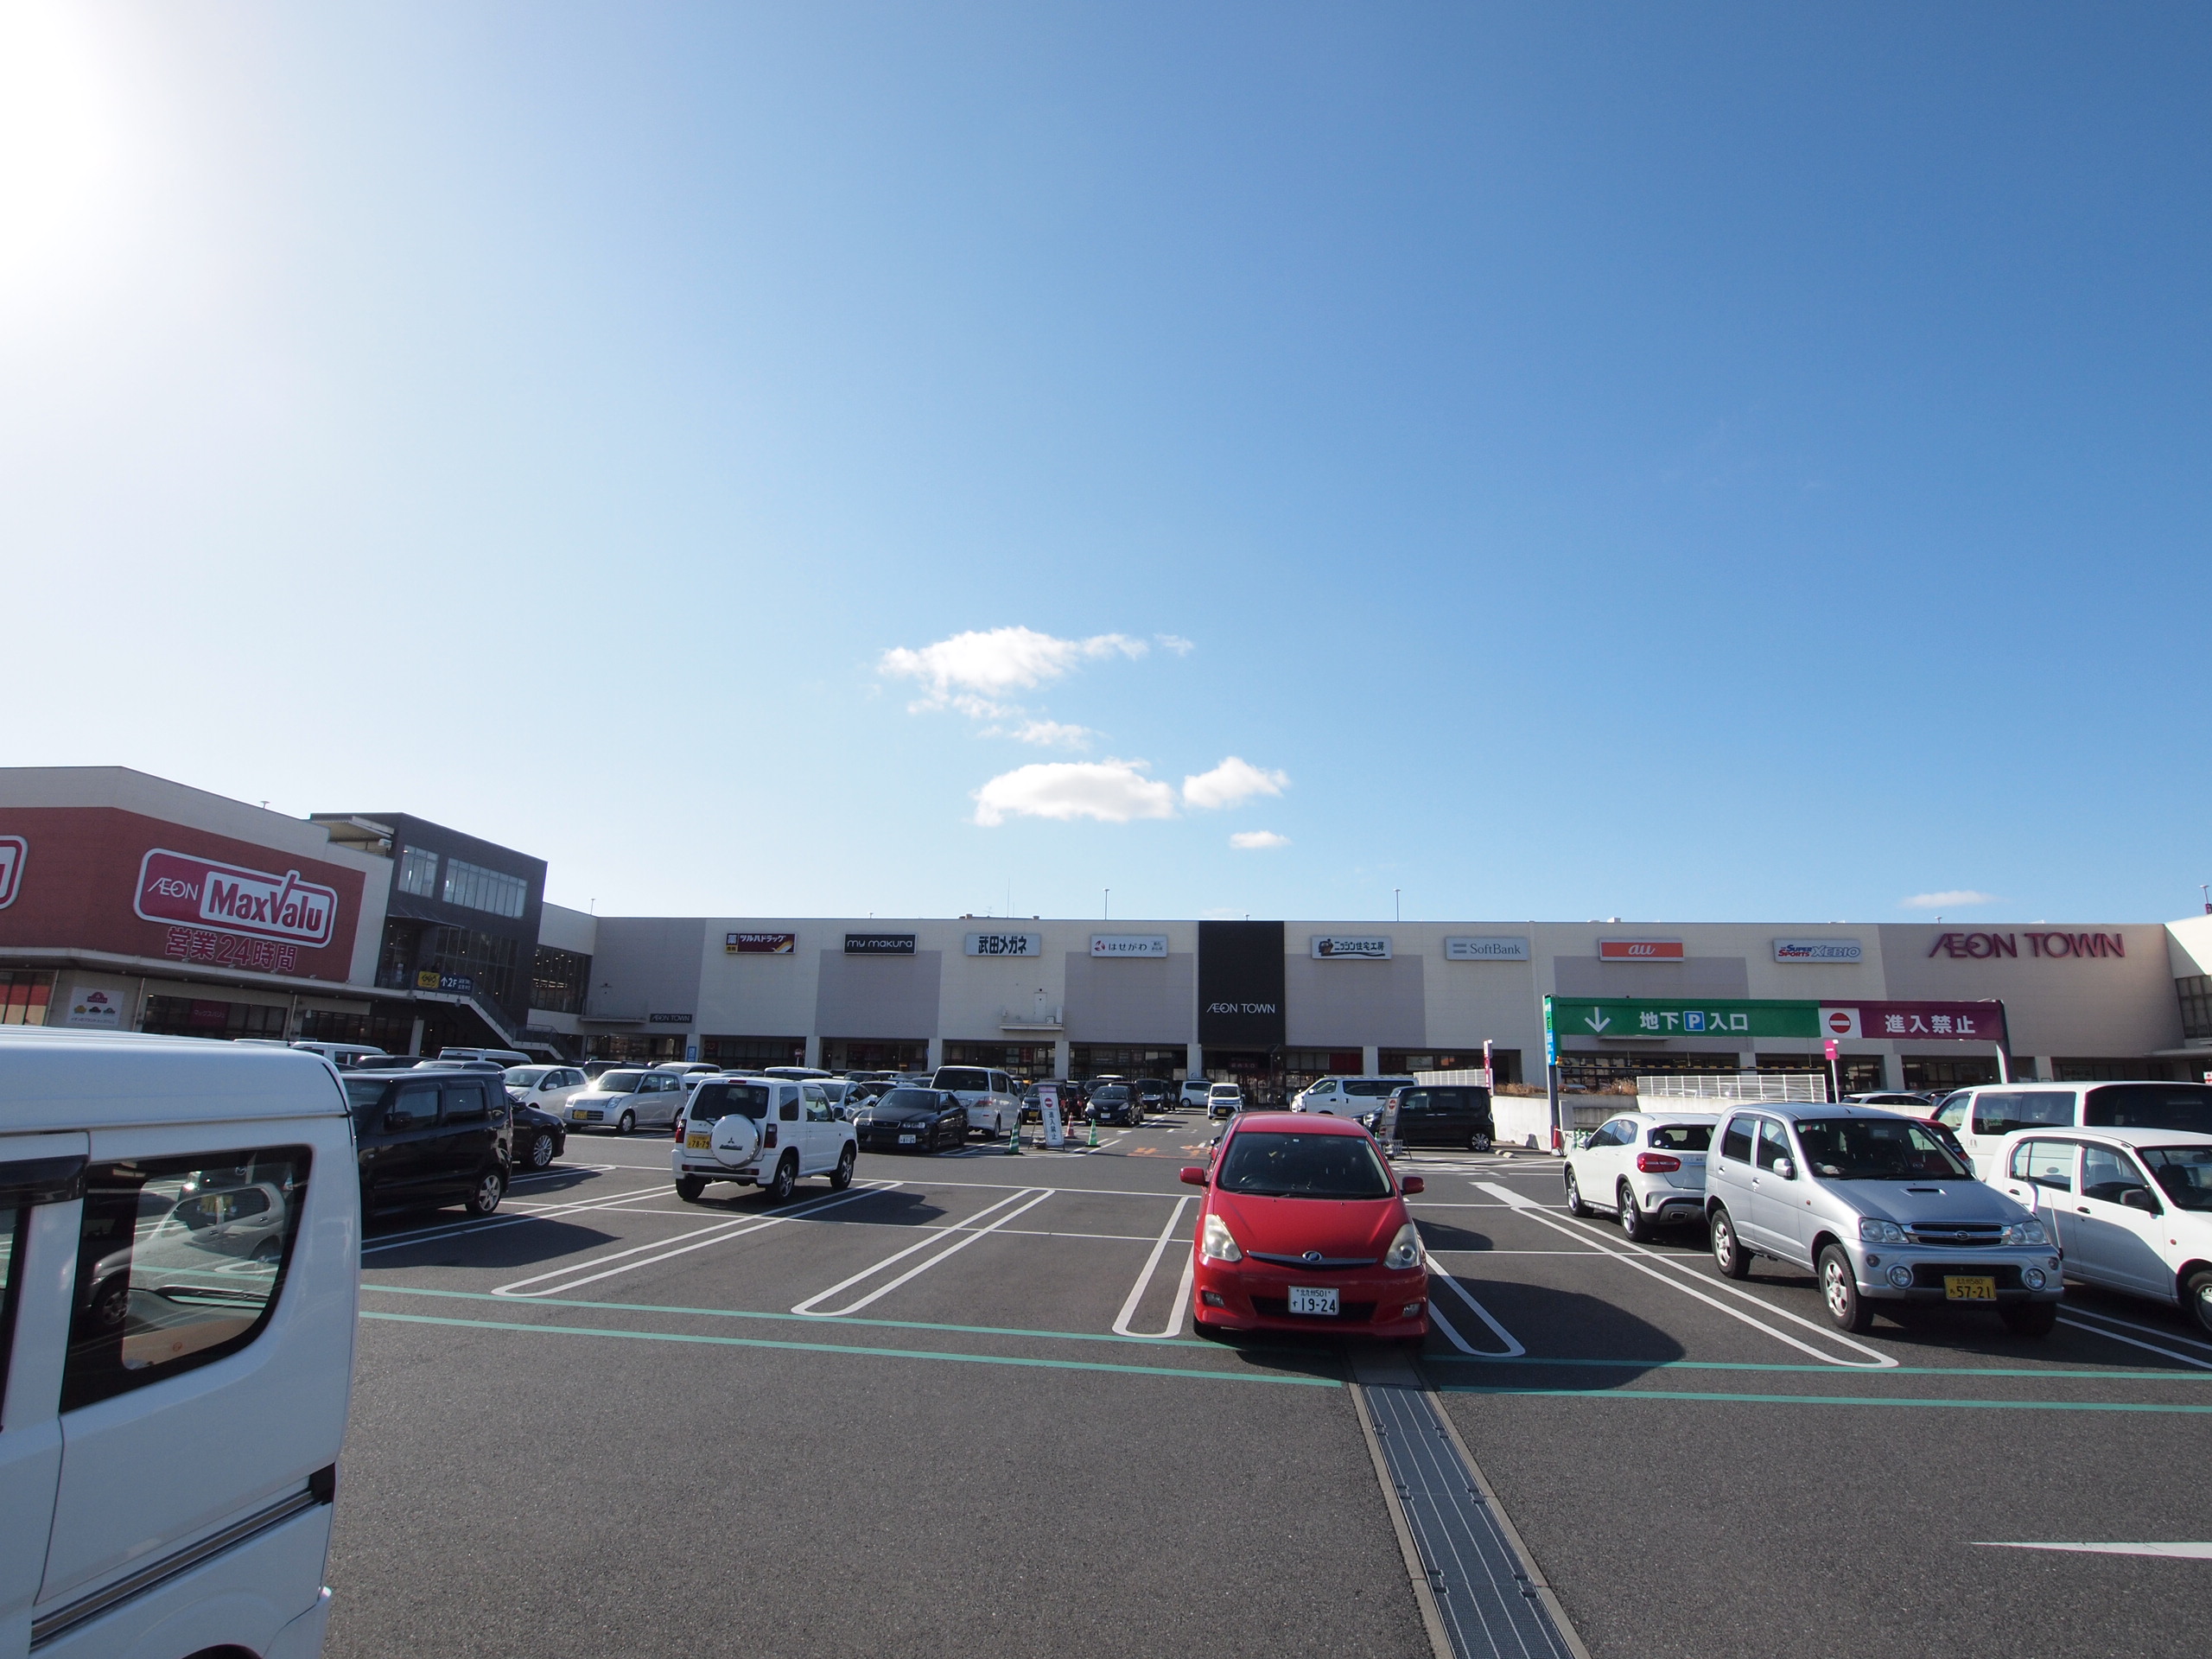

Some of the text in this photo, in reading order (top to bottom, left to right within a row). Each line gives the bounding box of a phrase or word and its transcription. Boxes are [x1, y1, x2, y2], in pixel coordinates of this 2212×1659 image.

[208, 874, 323, 931] MaxValu
[165, 927, 297, 972] 営業24時間
[847, 939, 912, 948] my makura
[978, 936, 1027, 954] 武田メガネ
[1108, 943, 1147, 951] はせがわ
[1470, 943, 1522, 955] SoftBank
[1628, 944, 1656, 956] au
[2024, 931, 2126, 958] TOWN
[1811, 945, 1861, 958] XEBIO
[447, 977, 458, 988] 2F
[1241, 1003, 1275, 1014] TOWN
[1885, 1014, 1976, 1034] 進入禁止
[1956, 1285, 1991, 1299] 57-21
[1302, 1298, 1336, 1313] 19-24
